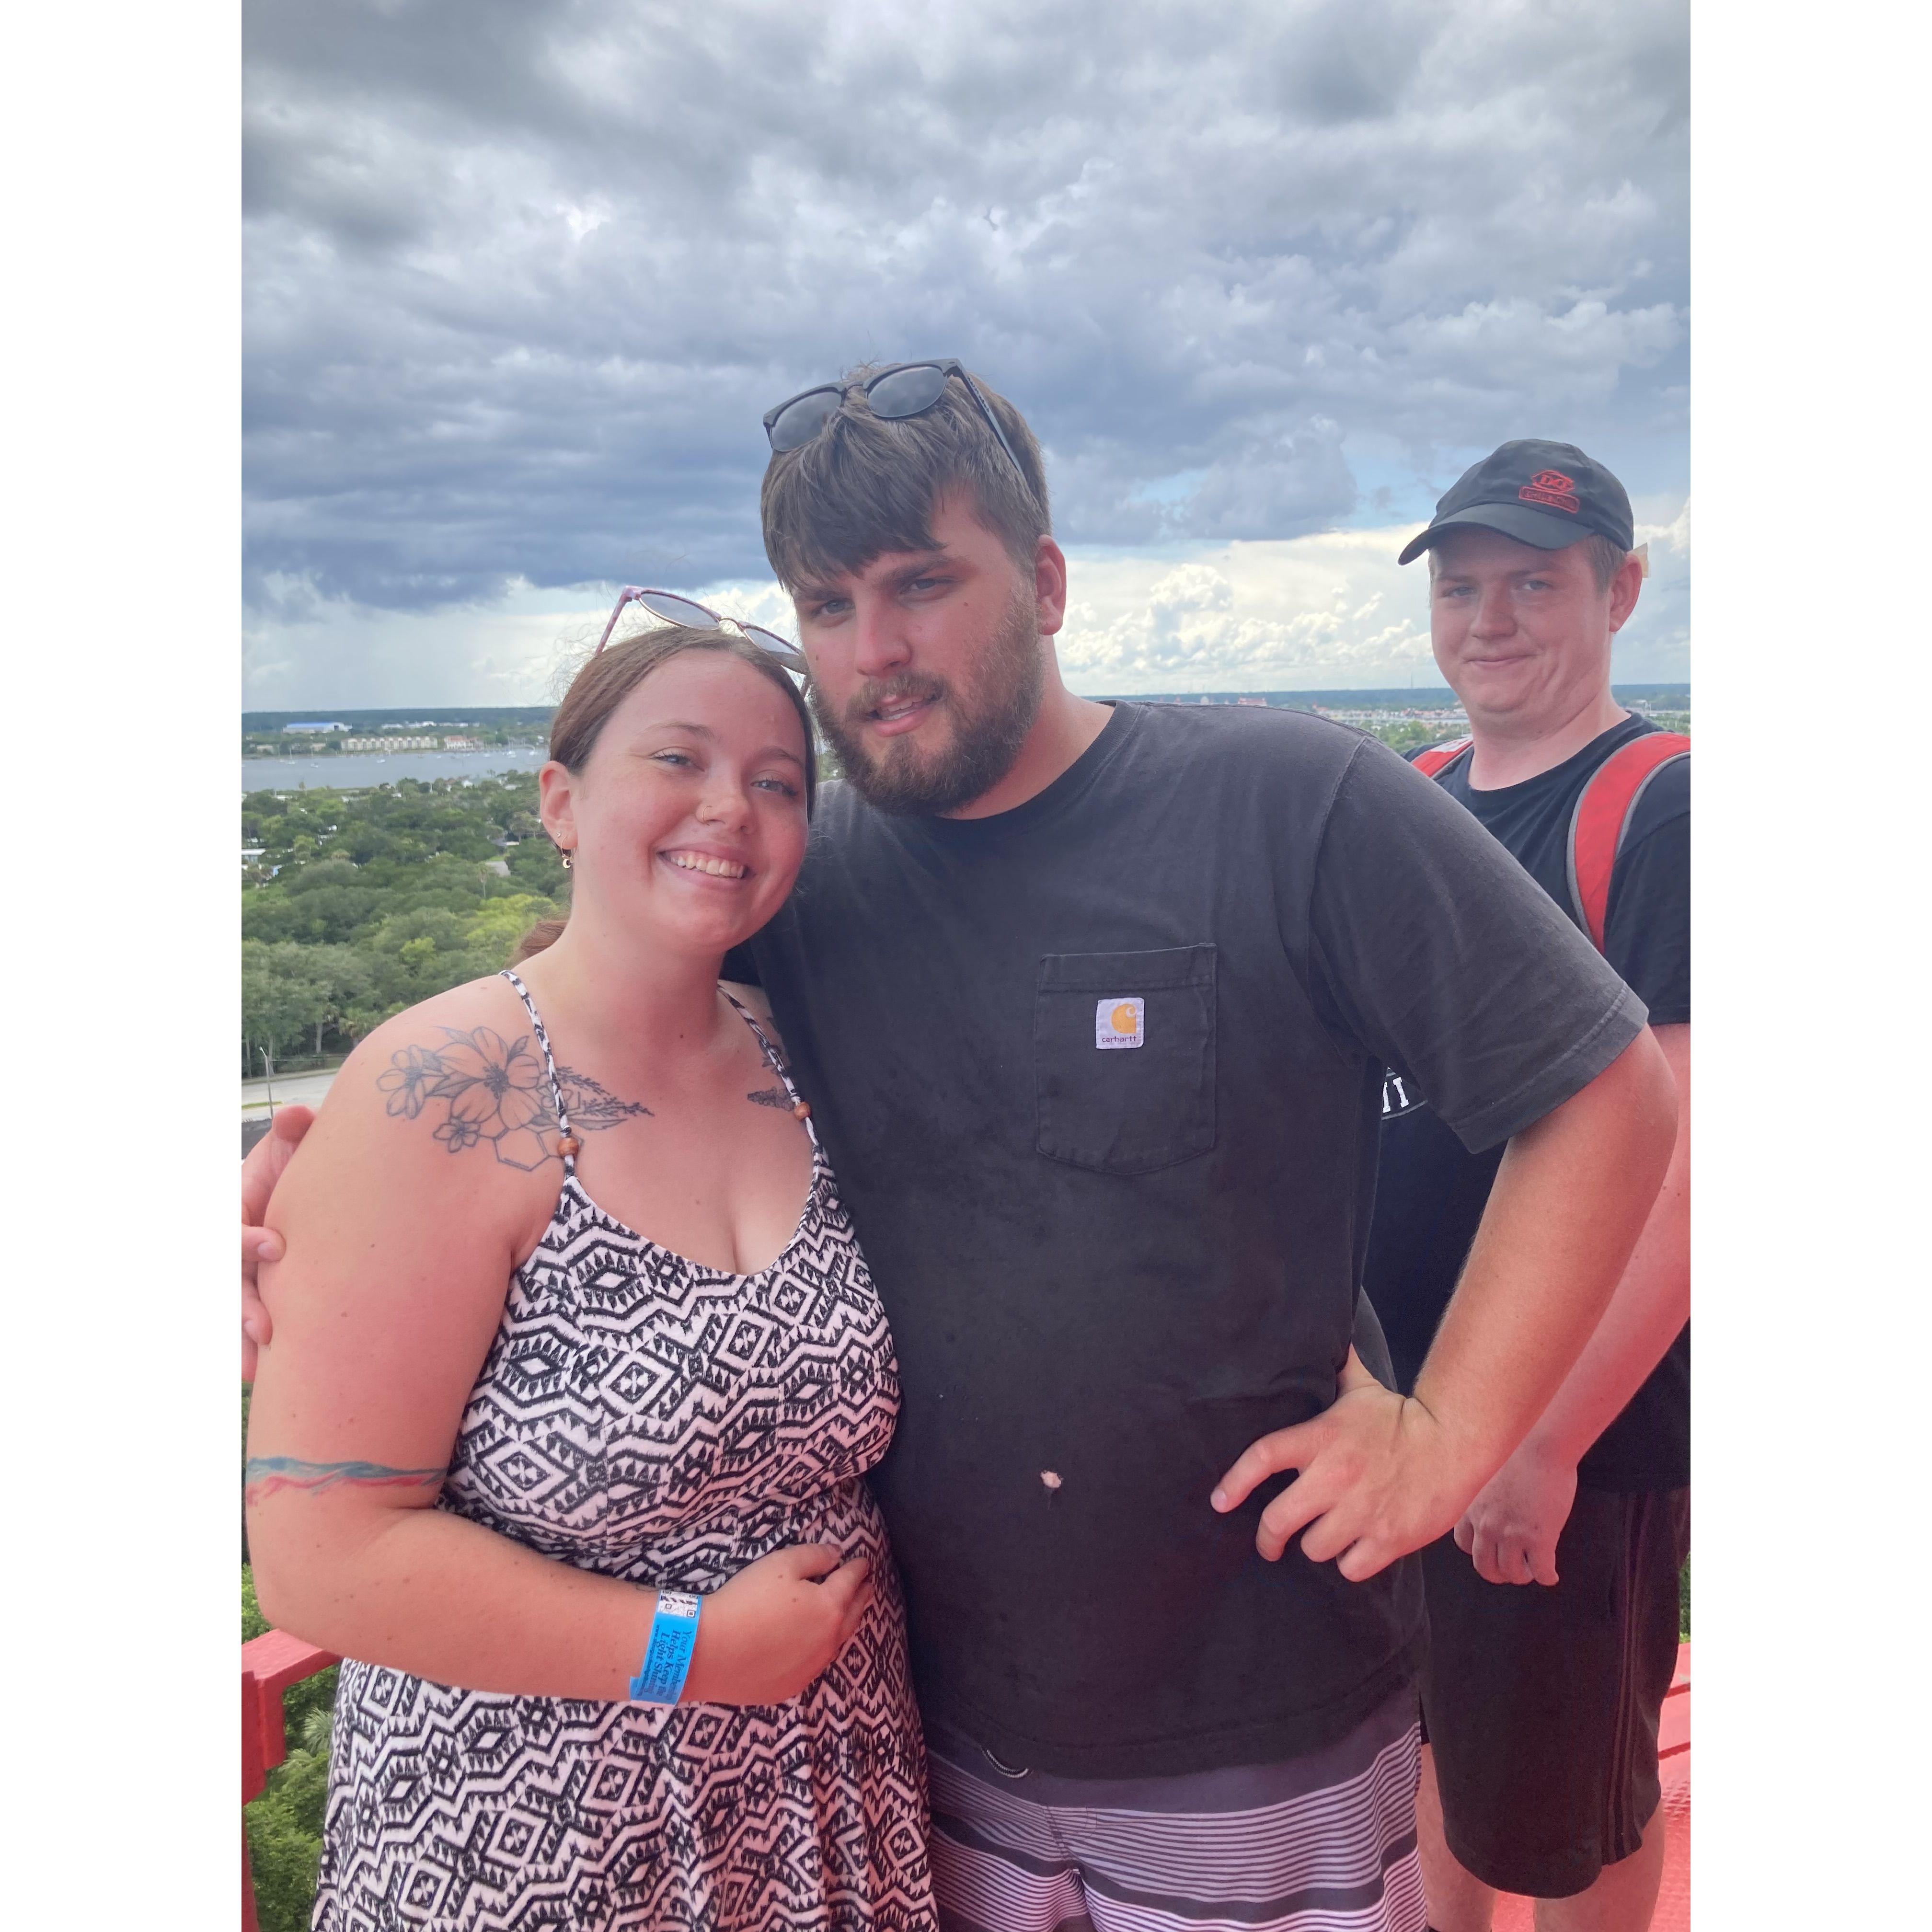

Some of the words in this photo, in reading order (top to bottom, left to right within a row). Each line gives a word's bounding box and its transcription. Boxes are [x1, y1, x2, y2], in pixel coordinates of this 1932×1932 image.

[655, 1632, 670, 1661] Light
[667, 1630, 681, 1659] Helps
[679, 1631, 692, 1654] Your
[657, 1661, 674, 1684] Keep
[666, 1655, 687, 1700] Member
